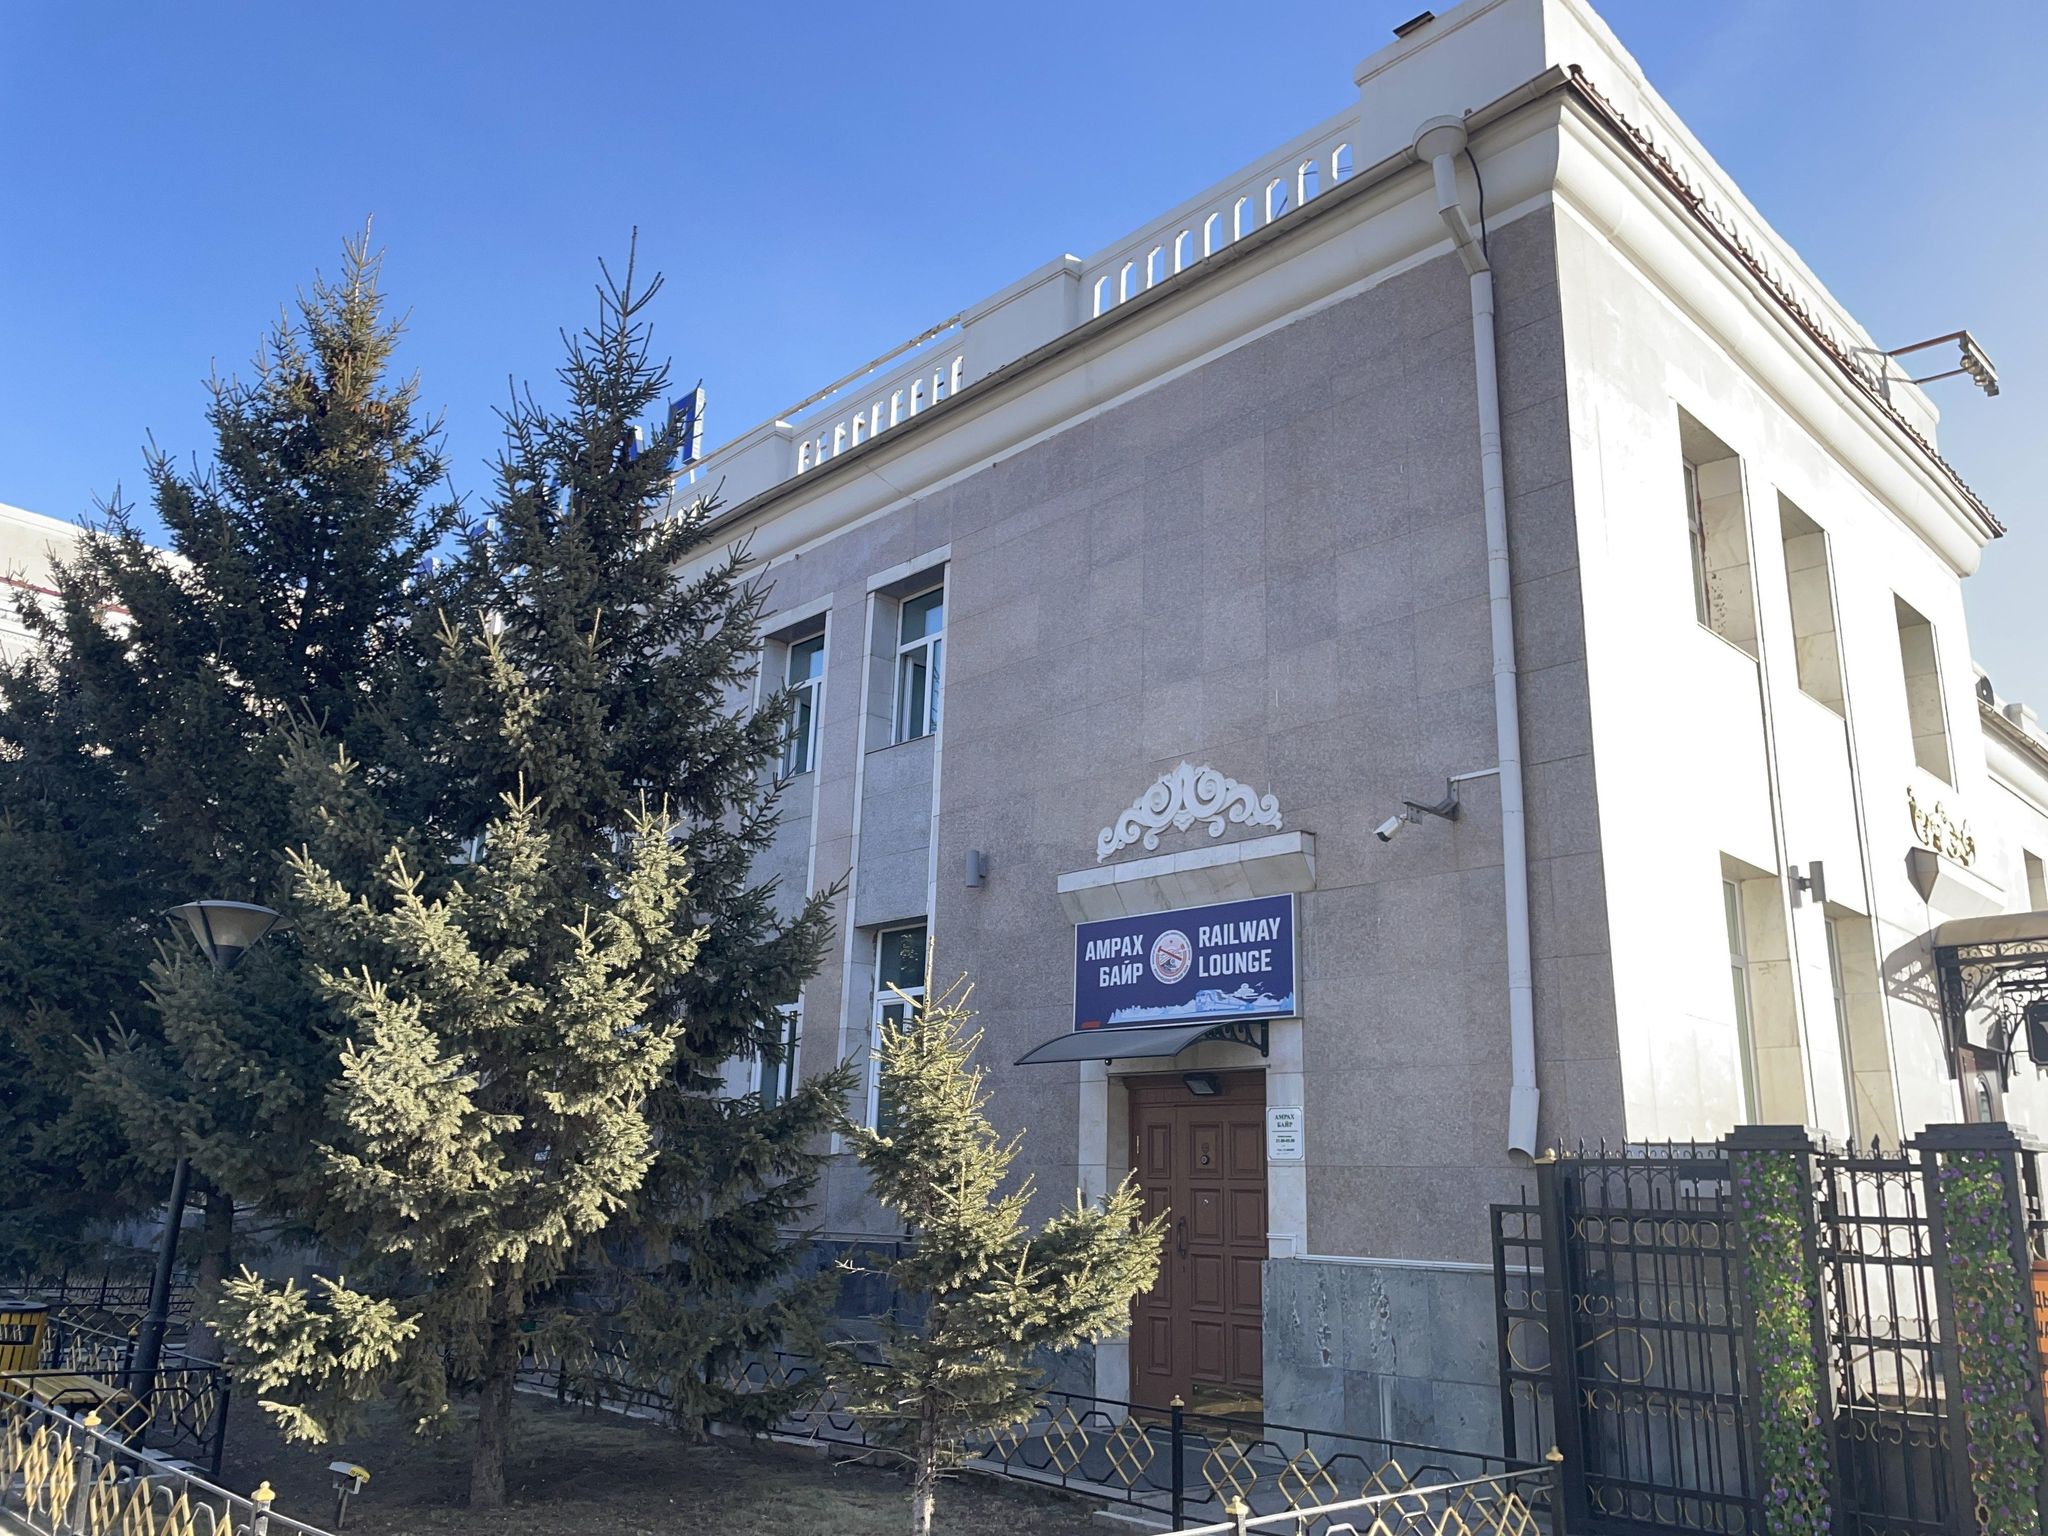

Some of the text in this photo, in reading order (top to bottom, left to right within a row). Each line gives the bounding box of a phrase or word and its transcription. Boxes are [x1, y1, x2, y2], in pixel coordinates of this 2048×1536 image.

[1198, 917, 1281, 948] RAILWAY
[1085, 934, 1144, 961] АМРАХ
[1099, 960, 1144, 988] БАЙР
[1198, 949, 1272, 978] LOUNGE
[1277, 1120, 1293, 1128] БАЙР
